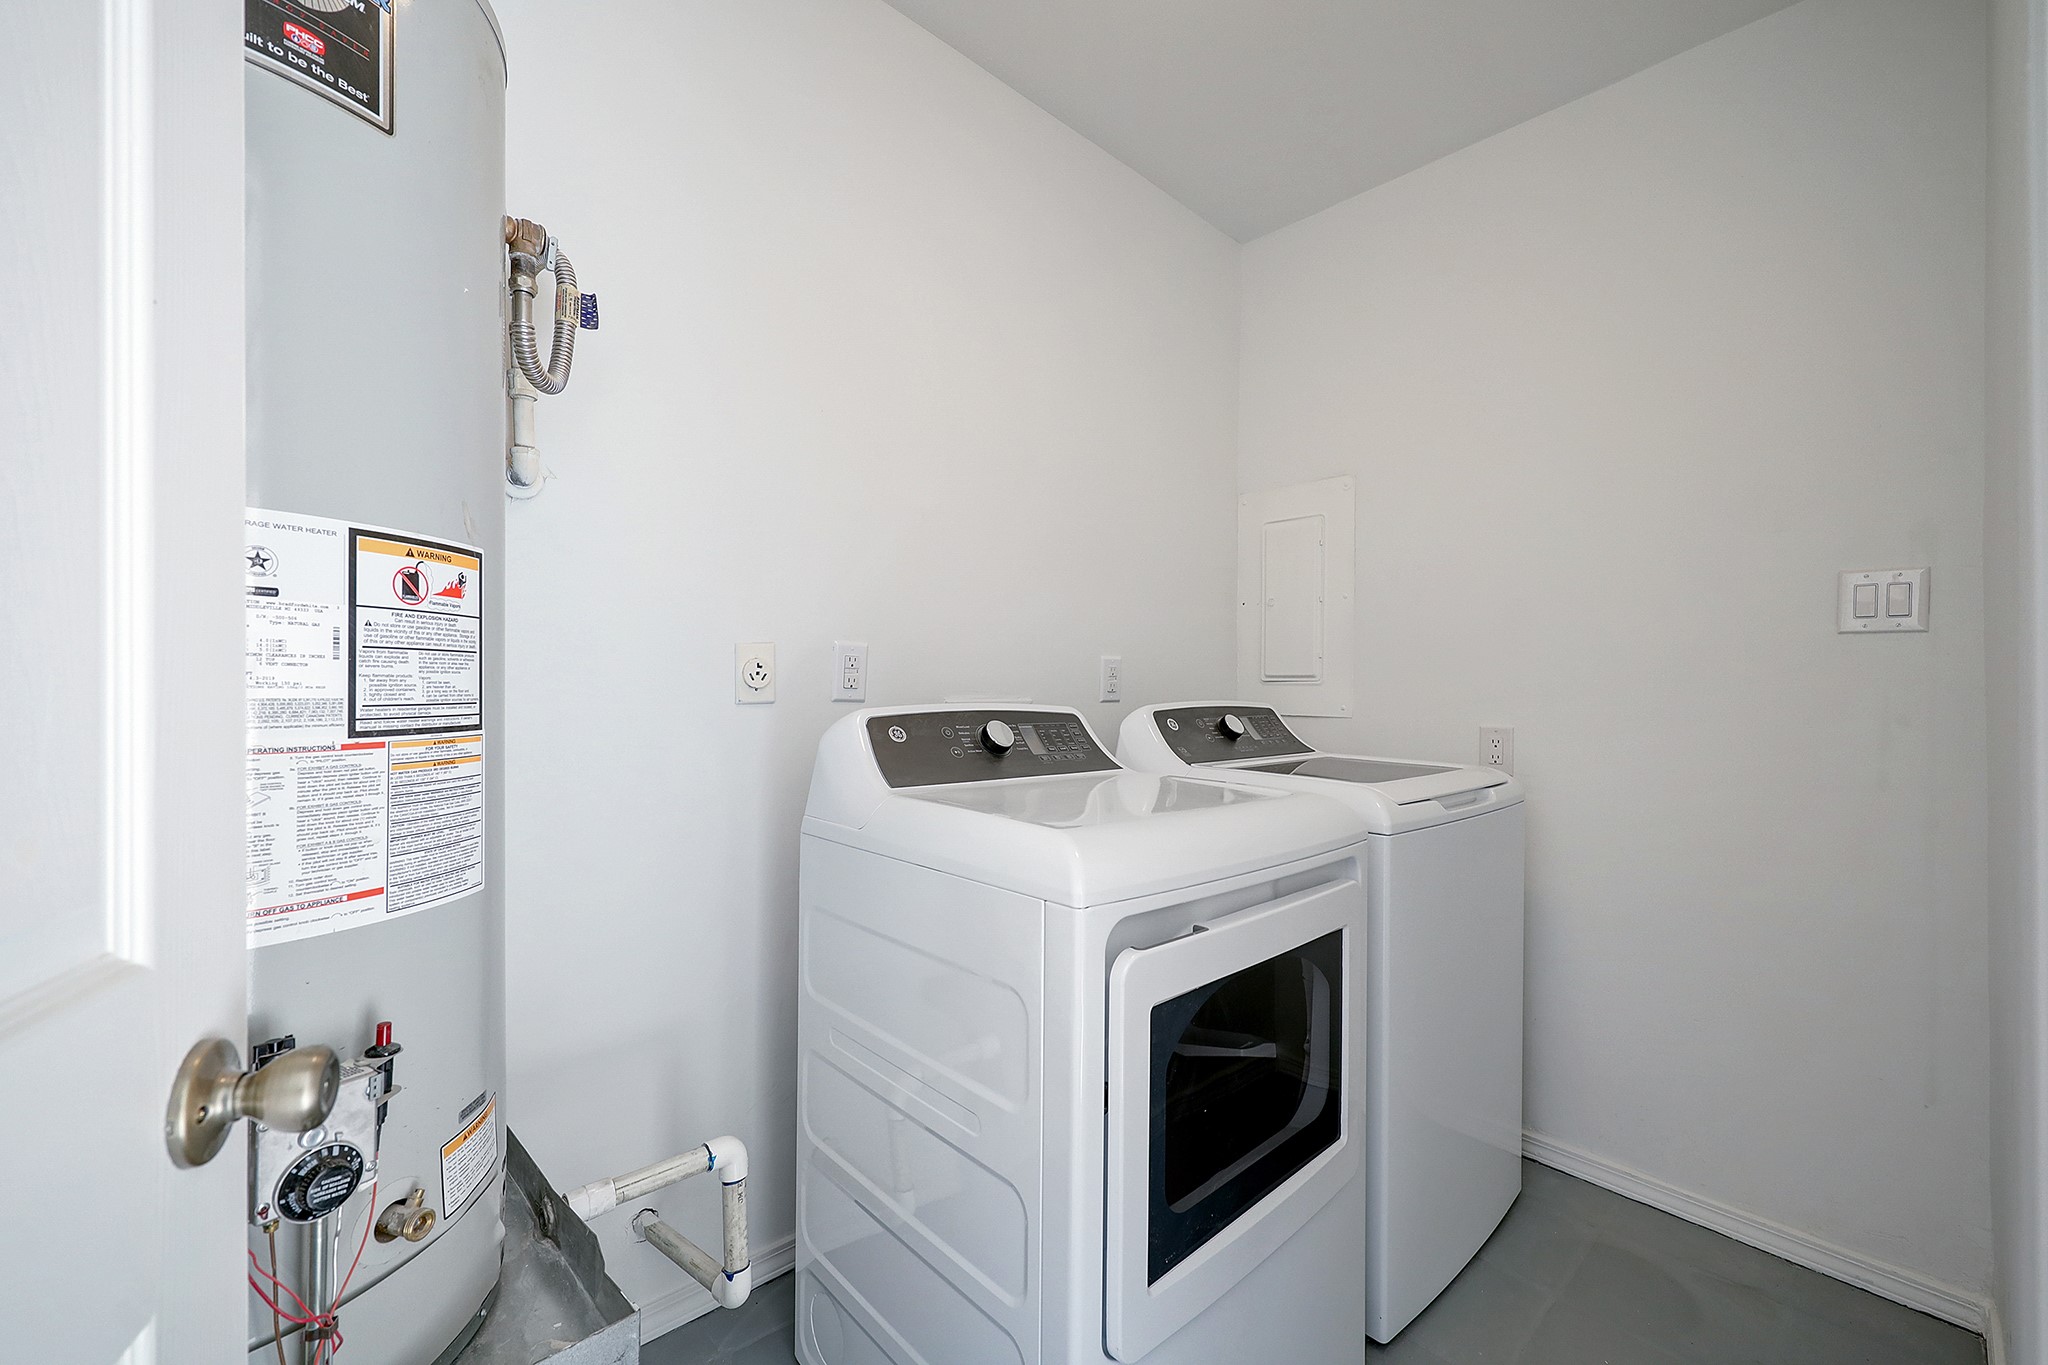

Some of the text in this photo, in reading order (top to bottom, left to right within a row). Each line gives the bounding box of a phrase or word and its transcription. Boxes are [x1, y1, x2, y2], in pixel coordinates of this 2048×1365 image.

[285, 23, 324, 49] PHCC
[320, 22, 370, 57] SAVER
[267, 41, 284, 56] to
[288, 50, 308, 69] be
[311, 62, 334, 83] the
[338, 78, 369, 102] Best
[272, 523, 303, 532] WATER
[305, 528, 337, 536] HEATER
[416, 550, 452, 563] WARNING
[279, 905, 294, 913] GAS
[307, 897, 344, 908] APPLIANCE
[466, 1111, 489, 1138] WARNING
